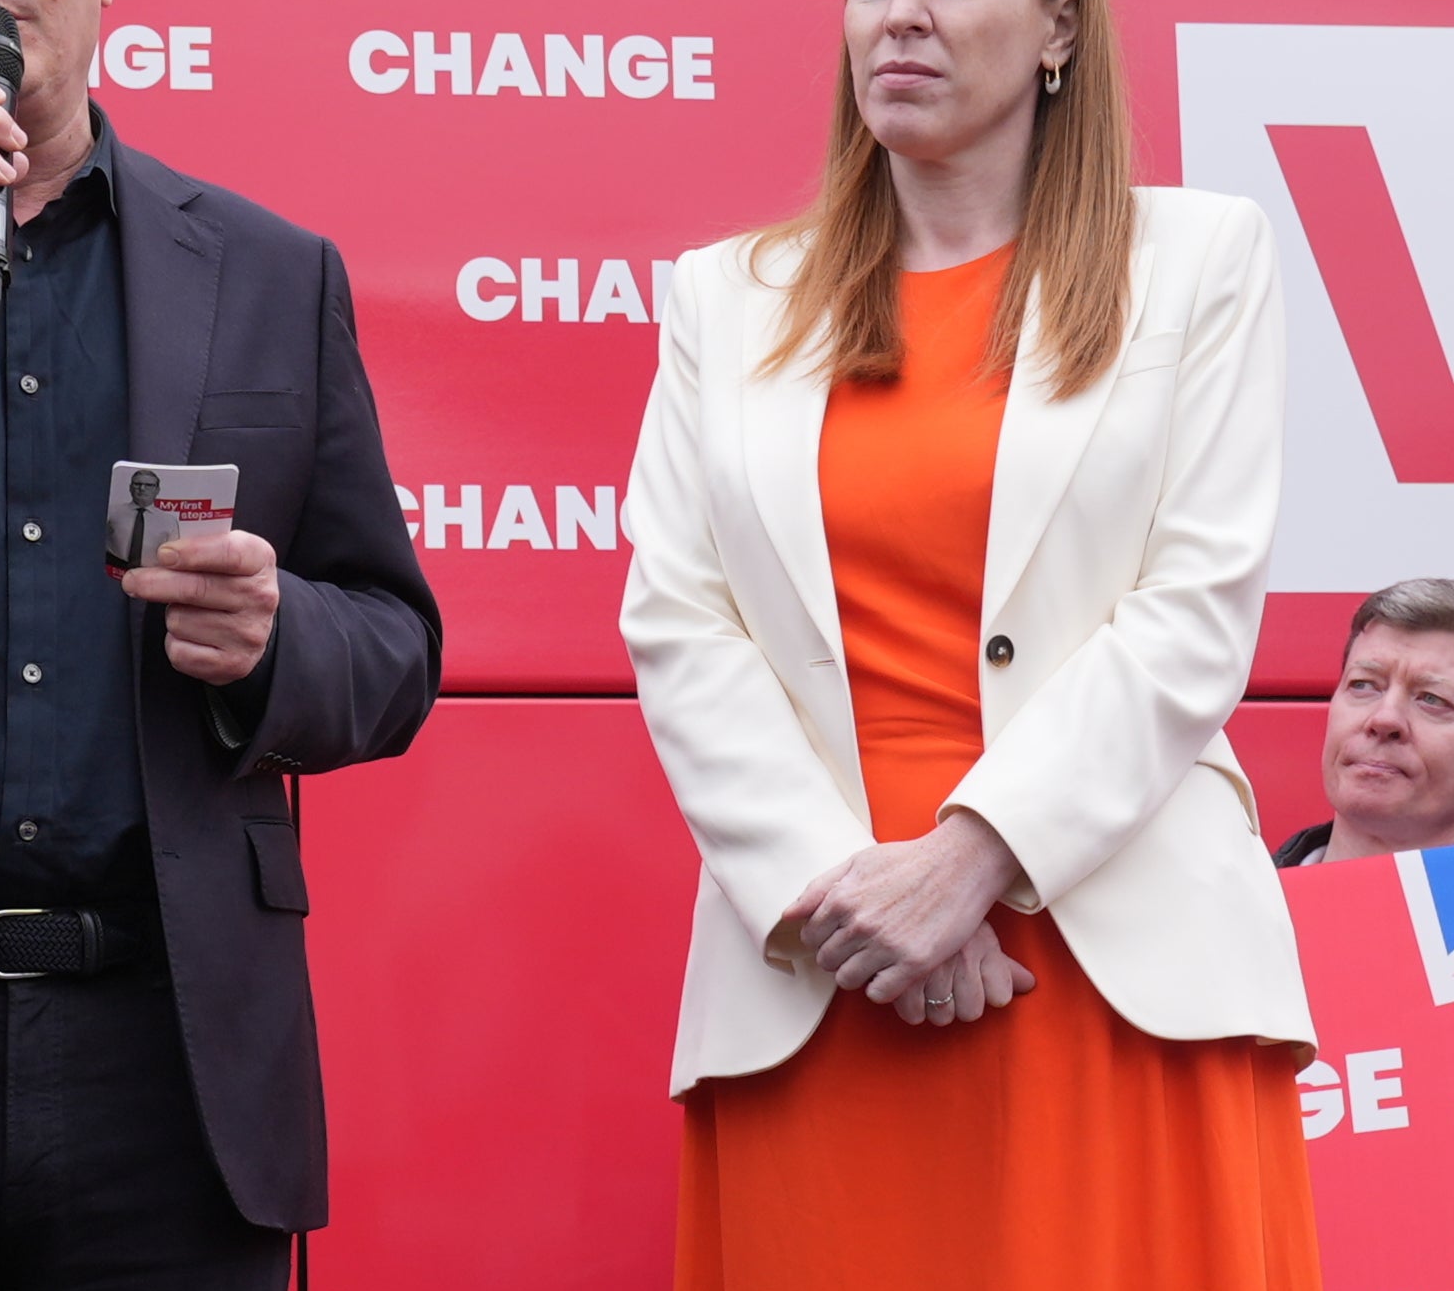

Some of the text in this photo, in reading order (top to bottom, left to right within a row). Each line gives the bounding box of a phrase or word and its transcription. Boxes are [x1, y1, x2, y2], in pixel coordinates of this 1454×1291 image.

[349, 30, 714, 99] CHANGE
[456, 257, 676, 323] CHA
[159, 501, 178, 511] My
